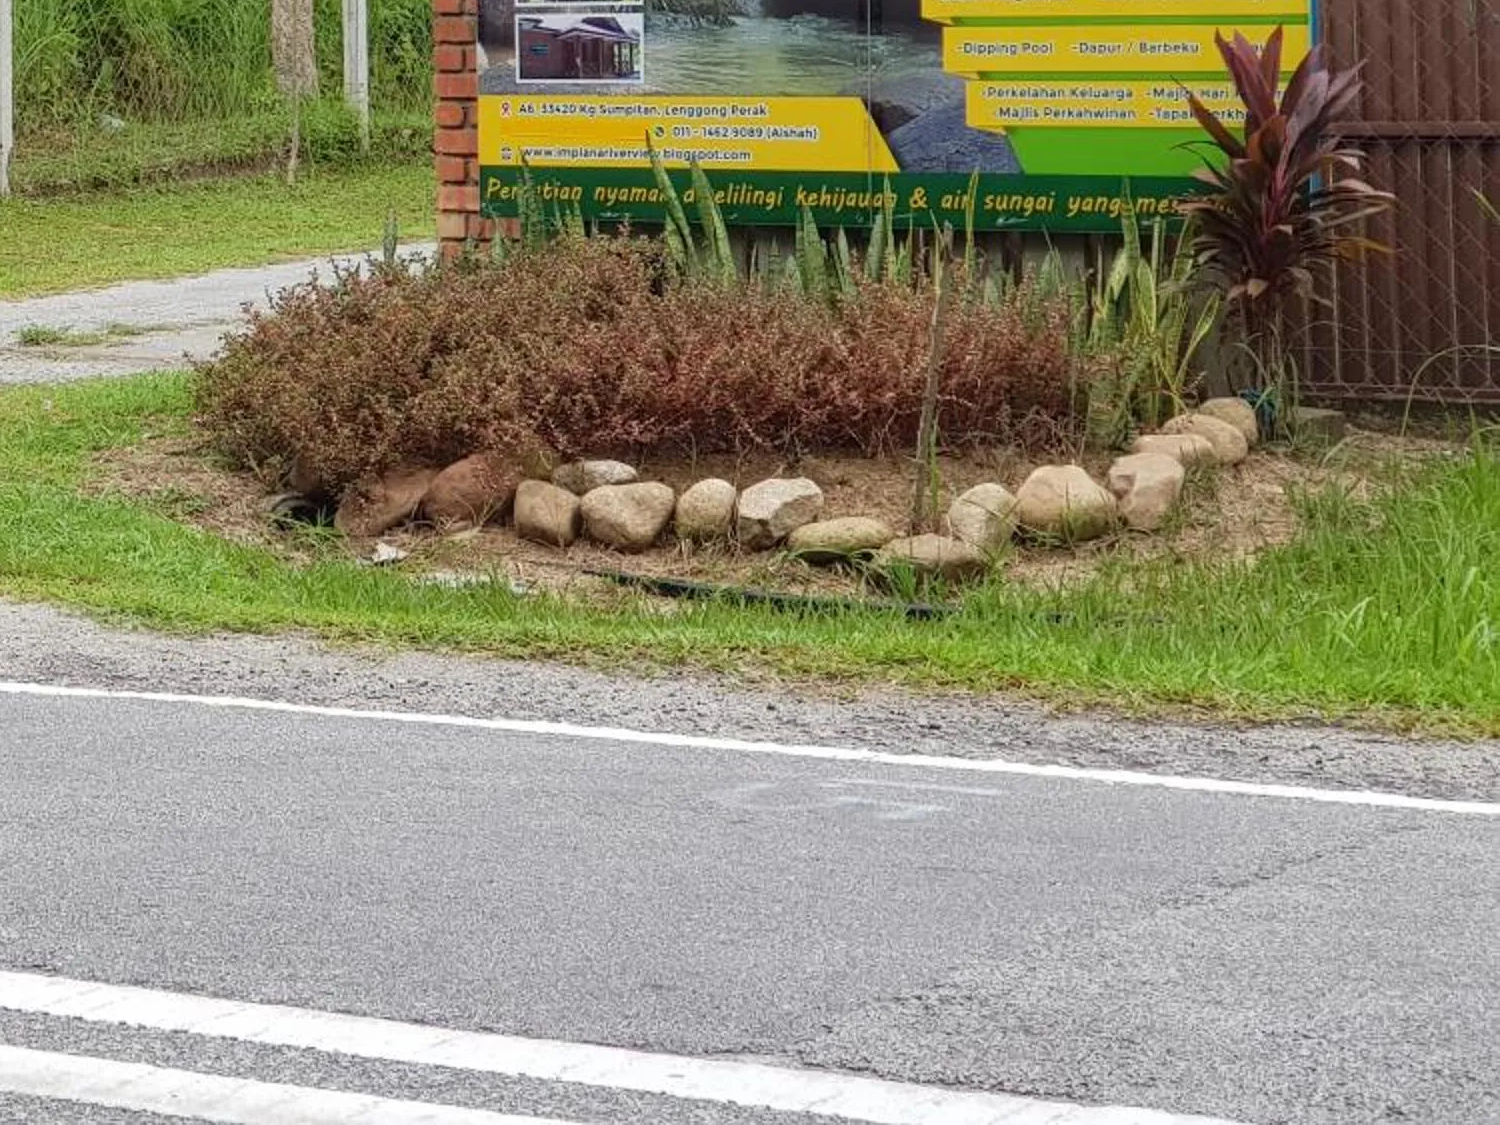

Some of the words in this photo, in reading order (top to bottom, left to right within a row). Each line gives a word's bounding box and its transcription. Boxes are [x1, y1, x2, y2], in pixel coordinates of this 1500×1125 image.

[1022, 42, 1053, 54] Pool
[1139, 42, 1199, 54] Barbeku
[1070, 86, 1133, 101] Keluarga
[666, 105, 730, 117] Lenggong
[732, 105, 767, 115] Perak
[1043, 106, 1136, 119] Perkahwinan
[487, 176, 583, 200] Pertian
[909, 188, 928, 209] &
[983, 191, 1057, 217] sungai
[1067, 196, 1124, 218] yang
